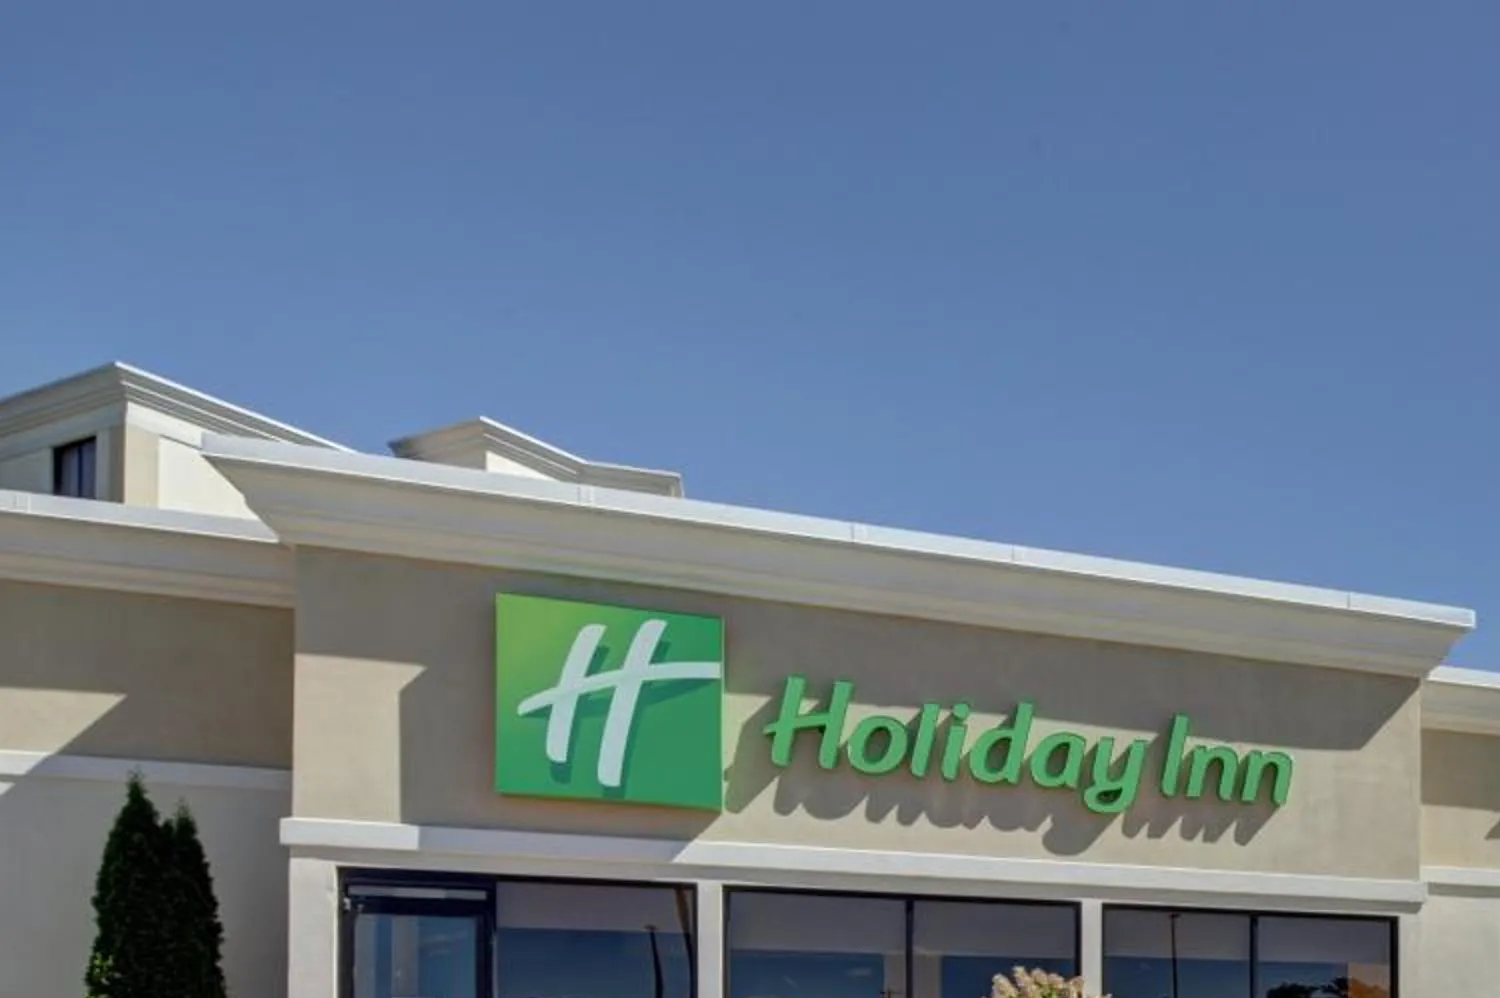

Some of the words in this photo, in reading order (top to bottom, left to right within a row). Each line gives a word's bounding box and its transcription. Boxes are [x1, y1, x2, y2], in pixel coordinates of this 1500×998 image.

[517, 618, 721, 787] H
[763, 674, 1148, 814] Holiday
[1158, 711, 1294, 806] Inn
